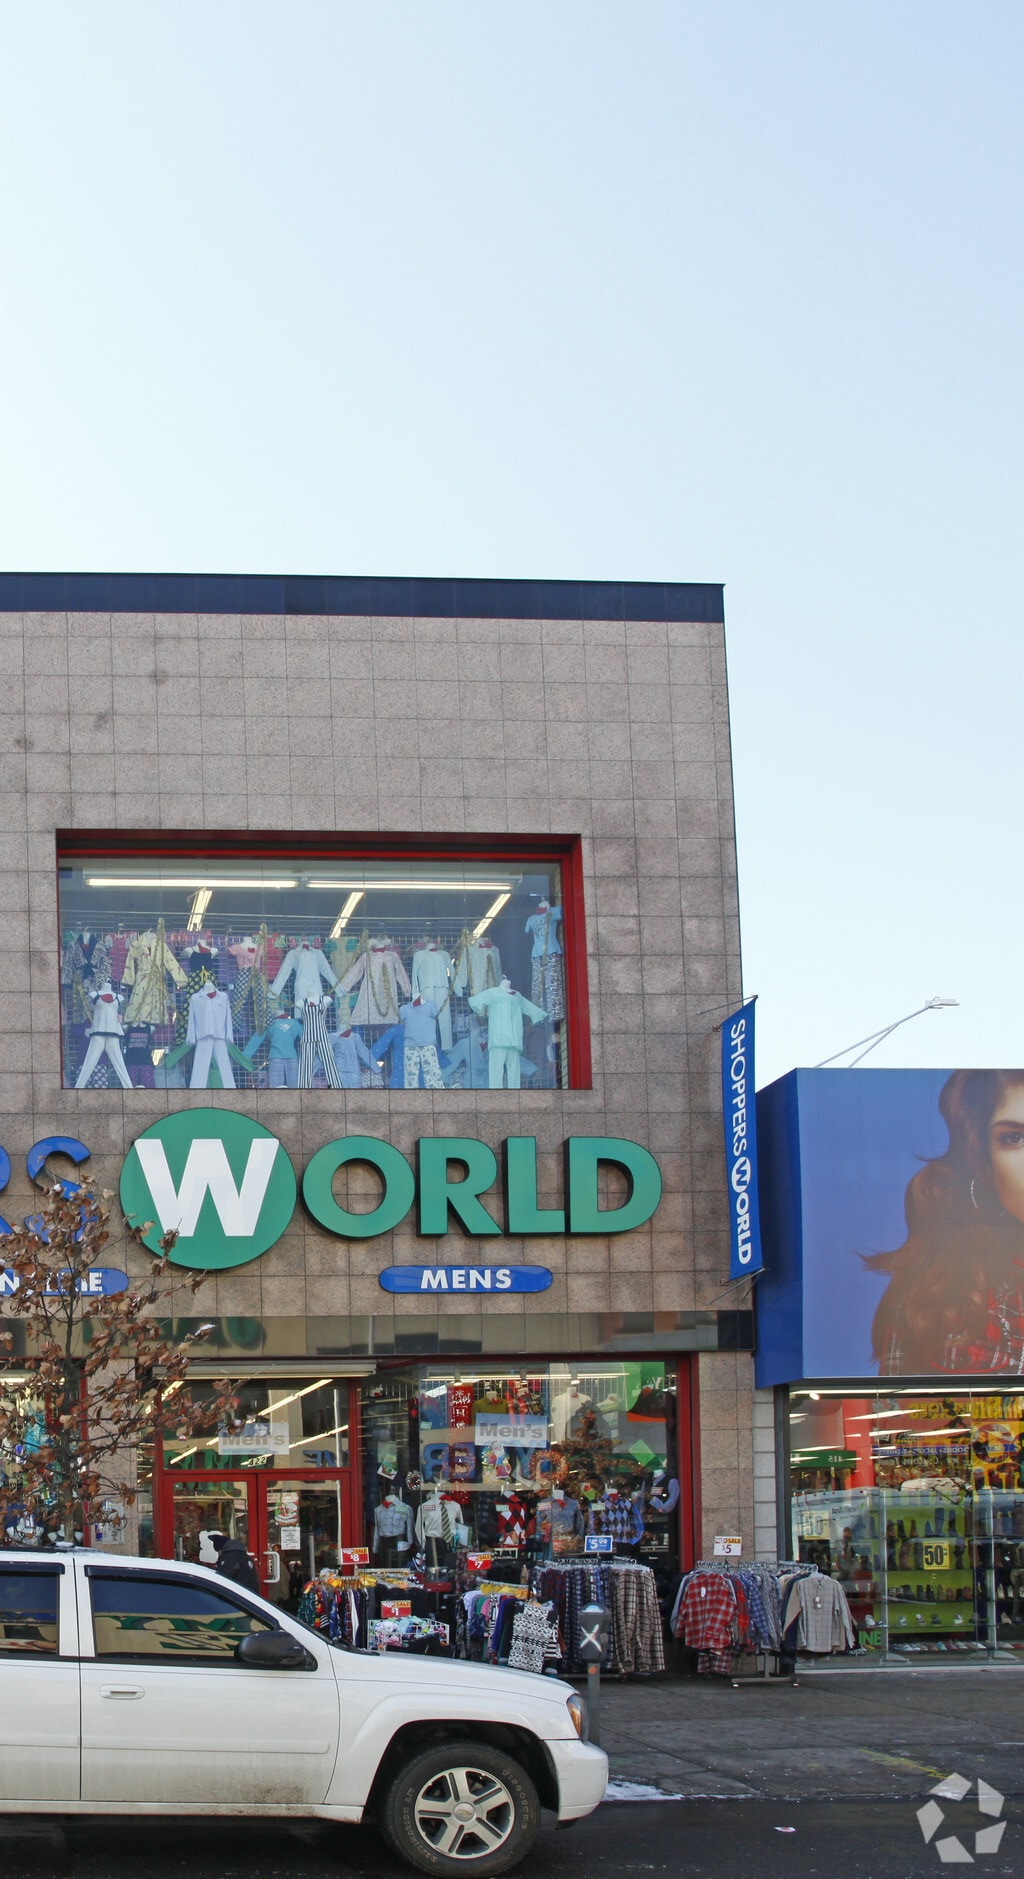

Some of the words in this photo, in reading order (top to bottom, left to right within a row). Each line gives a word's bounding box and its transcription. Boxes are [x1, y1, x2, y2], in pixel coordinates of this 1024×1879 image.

[730, 1018, 748, 1157] SHOPPERS
[134, 1135, 663, 1238] WORLD
[731, 1156, 752, 1265] WORLD
[421, 1269, 512, 1289] MENS
[479, 1422, 543, 1439] Men's
[222, 1434, 285, 1446] Men's
[249, 1456, 266, 1466] 422
[721, 1544, 732, 1554] $5
[350, 1553, 360, 1562] $8
[474, 1560, 483, 1569] $7
[391, 1607, 399, 1616] $1
